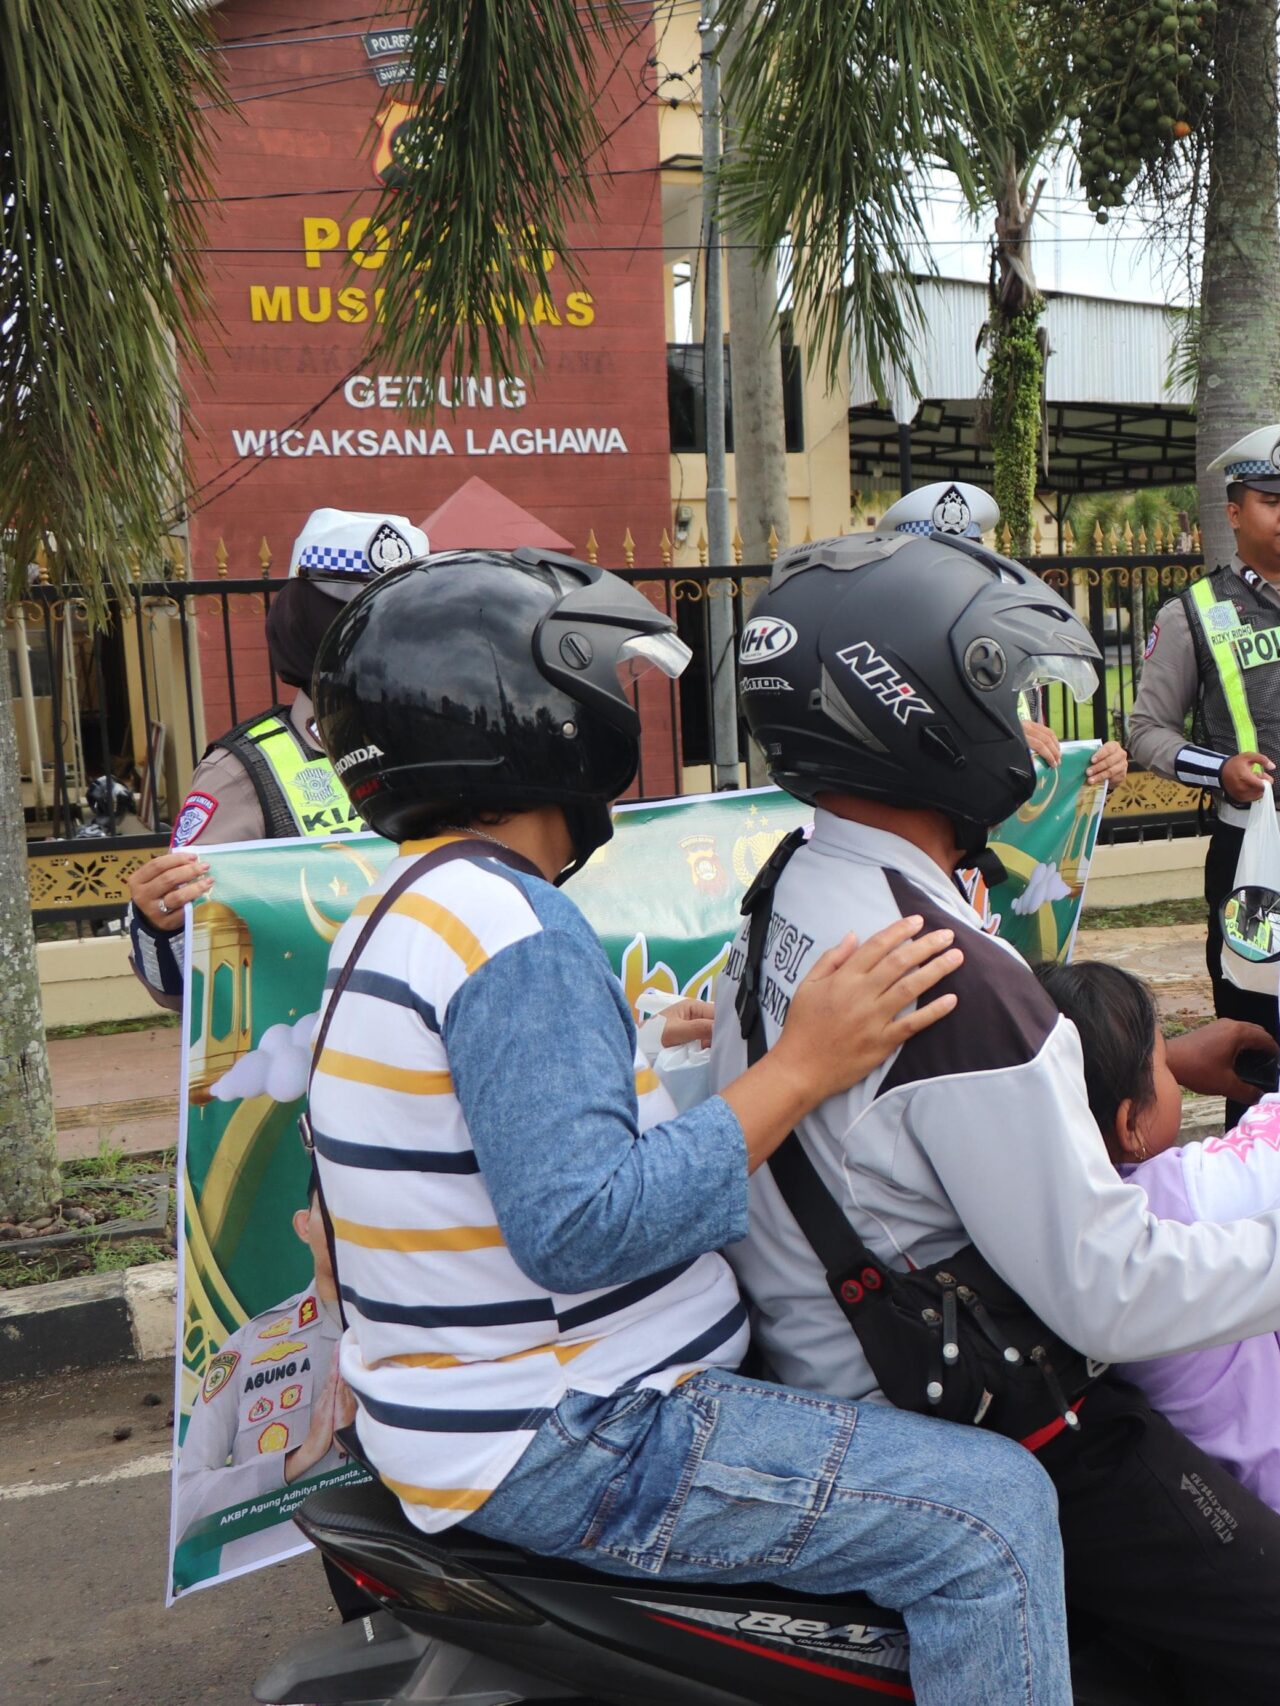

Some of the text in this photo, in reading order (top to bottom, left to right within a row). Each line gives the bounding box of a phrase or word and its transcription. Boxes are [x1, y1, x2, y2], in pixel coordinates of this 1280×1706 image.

[343, 375, 528, 409] GEDUNG
[231, 427, 629, 457] WICAKSANA LAGHAWA
[334, 744, 385, 777] HONDA
[243, 1357, 311, 1394] AGUNG A
[219, 1508, 249, 1526] AKBP
[249, 1497, 281, 1514] Agung
[281, 1484, 318, 1502] Adhitya
